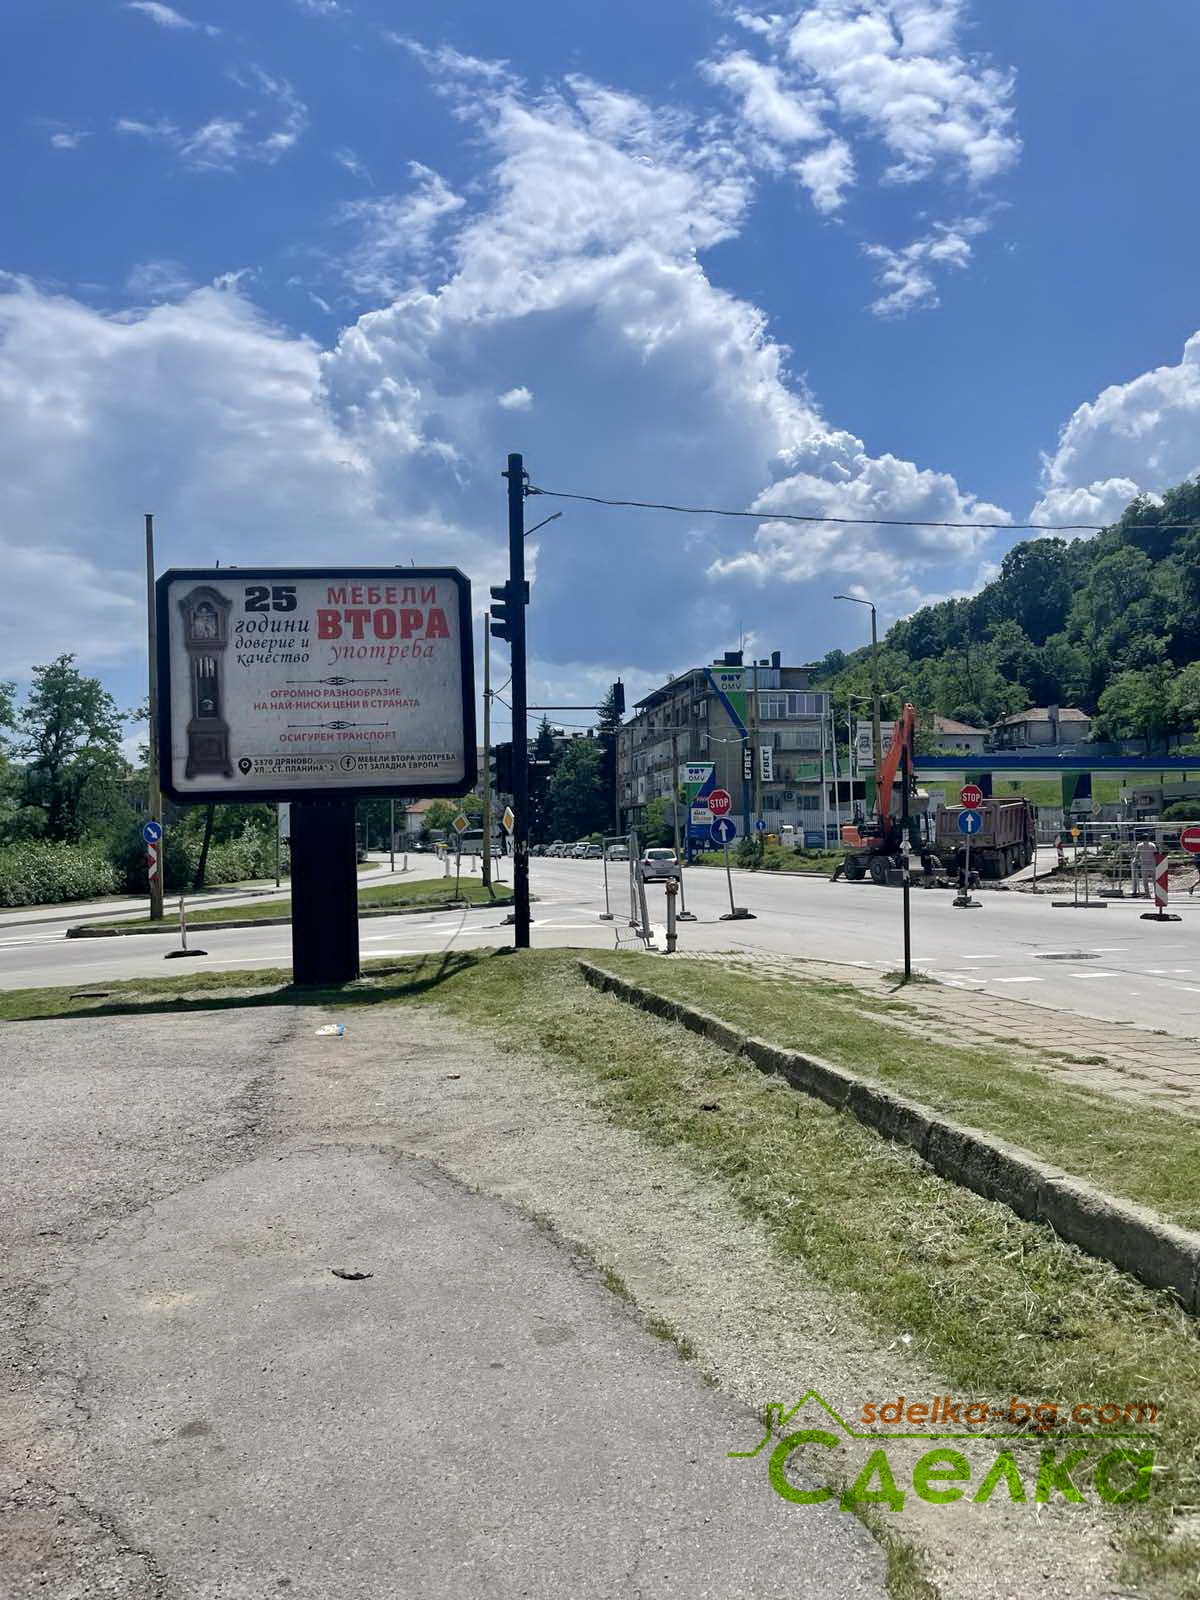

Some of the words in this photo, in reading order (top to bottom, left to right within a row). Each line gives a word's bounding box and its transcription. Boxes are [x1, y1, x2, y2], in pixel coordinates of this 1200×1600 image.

[245, 586, 298, 613] 25
[327, 586, 437, 605] МЕБЕЛИ
[235, 613, 310, 633] години
[316, 608, 450, 640] ВТОРА
[235, 635, 295, 654] доверие
[301, 639, 310, 649] и
[328, 638, 434, 666] употреба
[236, 652, 310, 668] качество
[270, 688, 323, 699] ОГРОМНО
[323, 687, 401, 697] РАЗНООБРАЗИЕ
[253, 702, 268, 711] НА
[332, 700, 360, 710] ЦЕНИ
[362, 700, 369, 708] В
[370, 699, 421, 708] СТРАНАТА
[279, 732, 336, 743] ОСИГУРЕН
[336, 731, 397, 741] ТРАНСПОРТ
[357, 755, 390, 763] МЕБЕЛИ
[391, 754, 415, 762] ВТОРА
[416, 753, 456, 761] УПОТРЕБА
[709, 798, 729, 809] STOP
[962, 792, 981, 802] STOP
